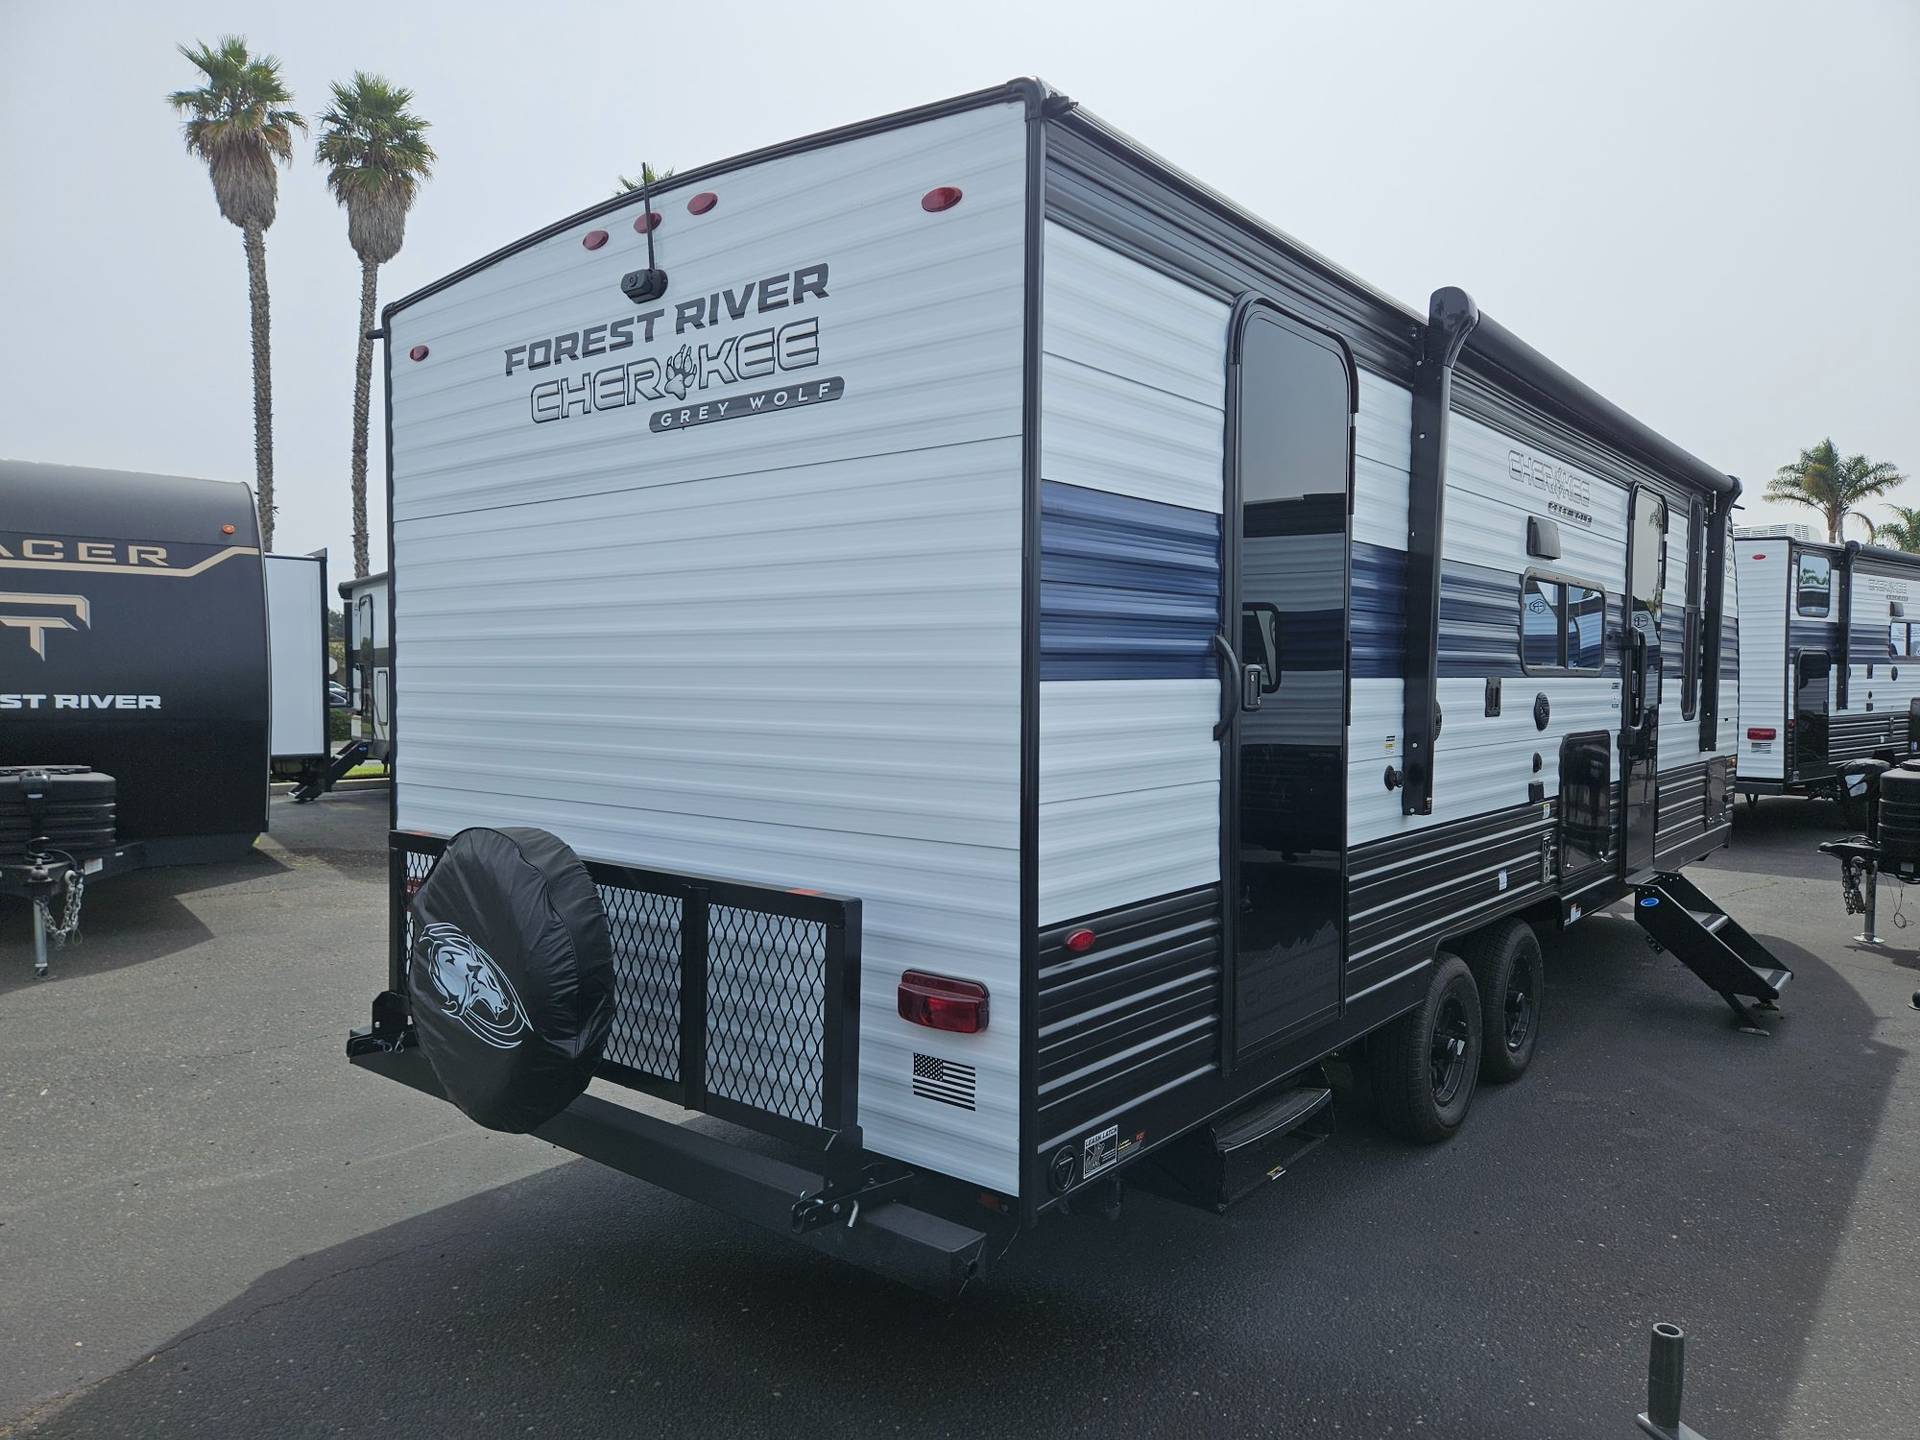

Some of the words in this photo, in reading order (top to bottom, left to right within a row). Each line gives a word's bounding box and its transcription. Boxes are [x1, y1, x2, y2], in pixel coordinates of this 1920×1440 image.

[504, 309, 665, 376] FOREST
[674, 262, 830, 335] RIVER
[660, 401, 729, 427] GREY
[749, 382, 833, 410] WOLF
[53, 694, 161, 709] RIVER
